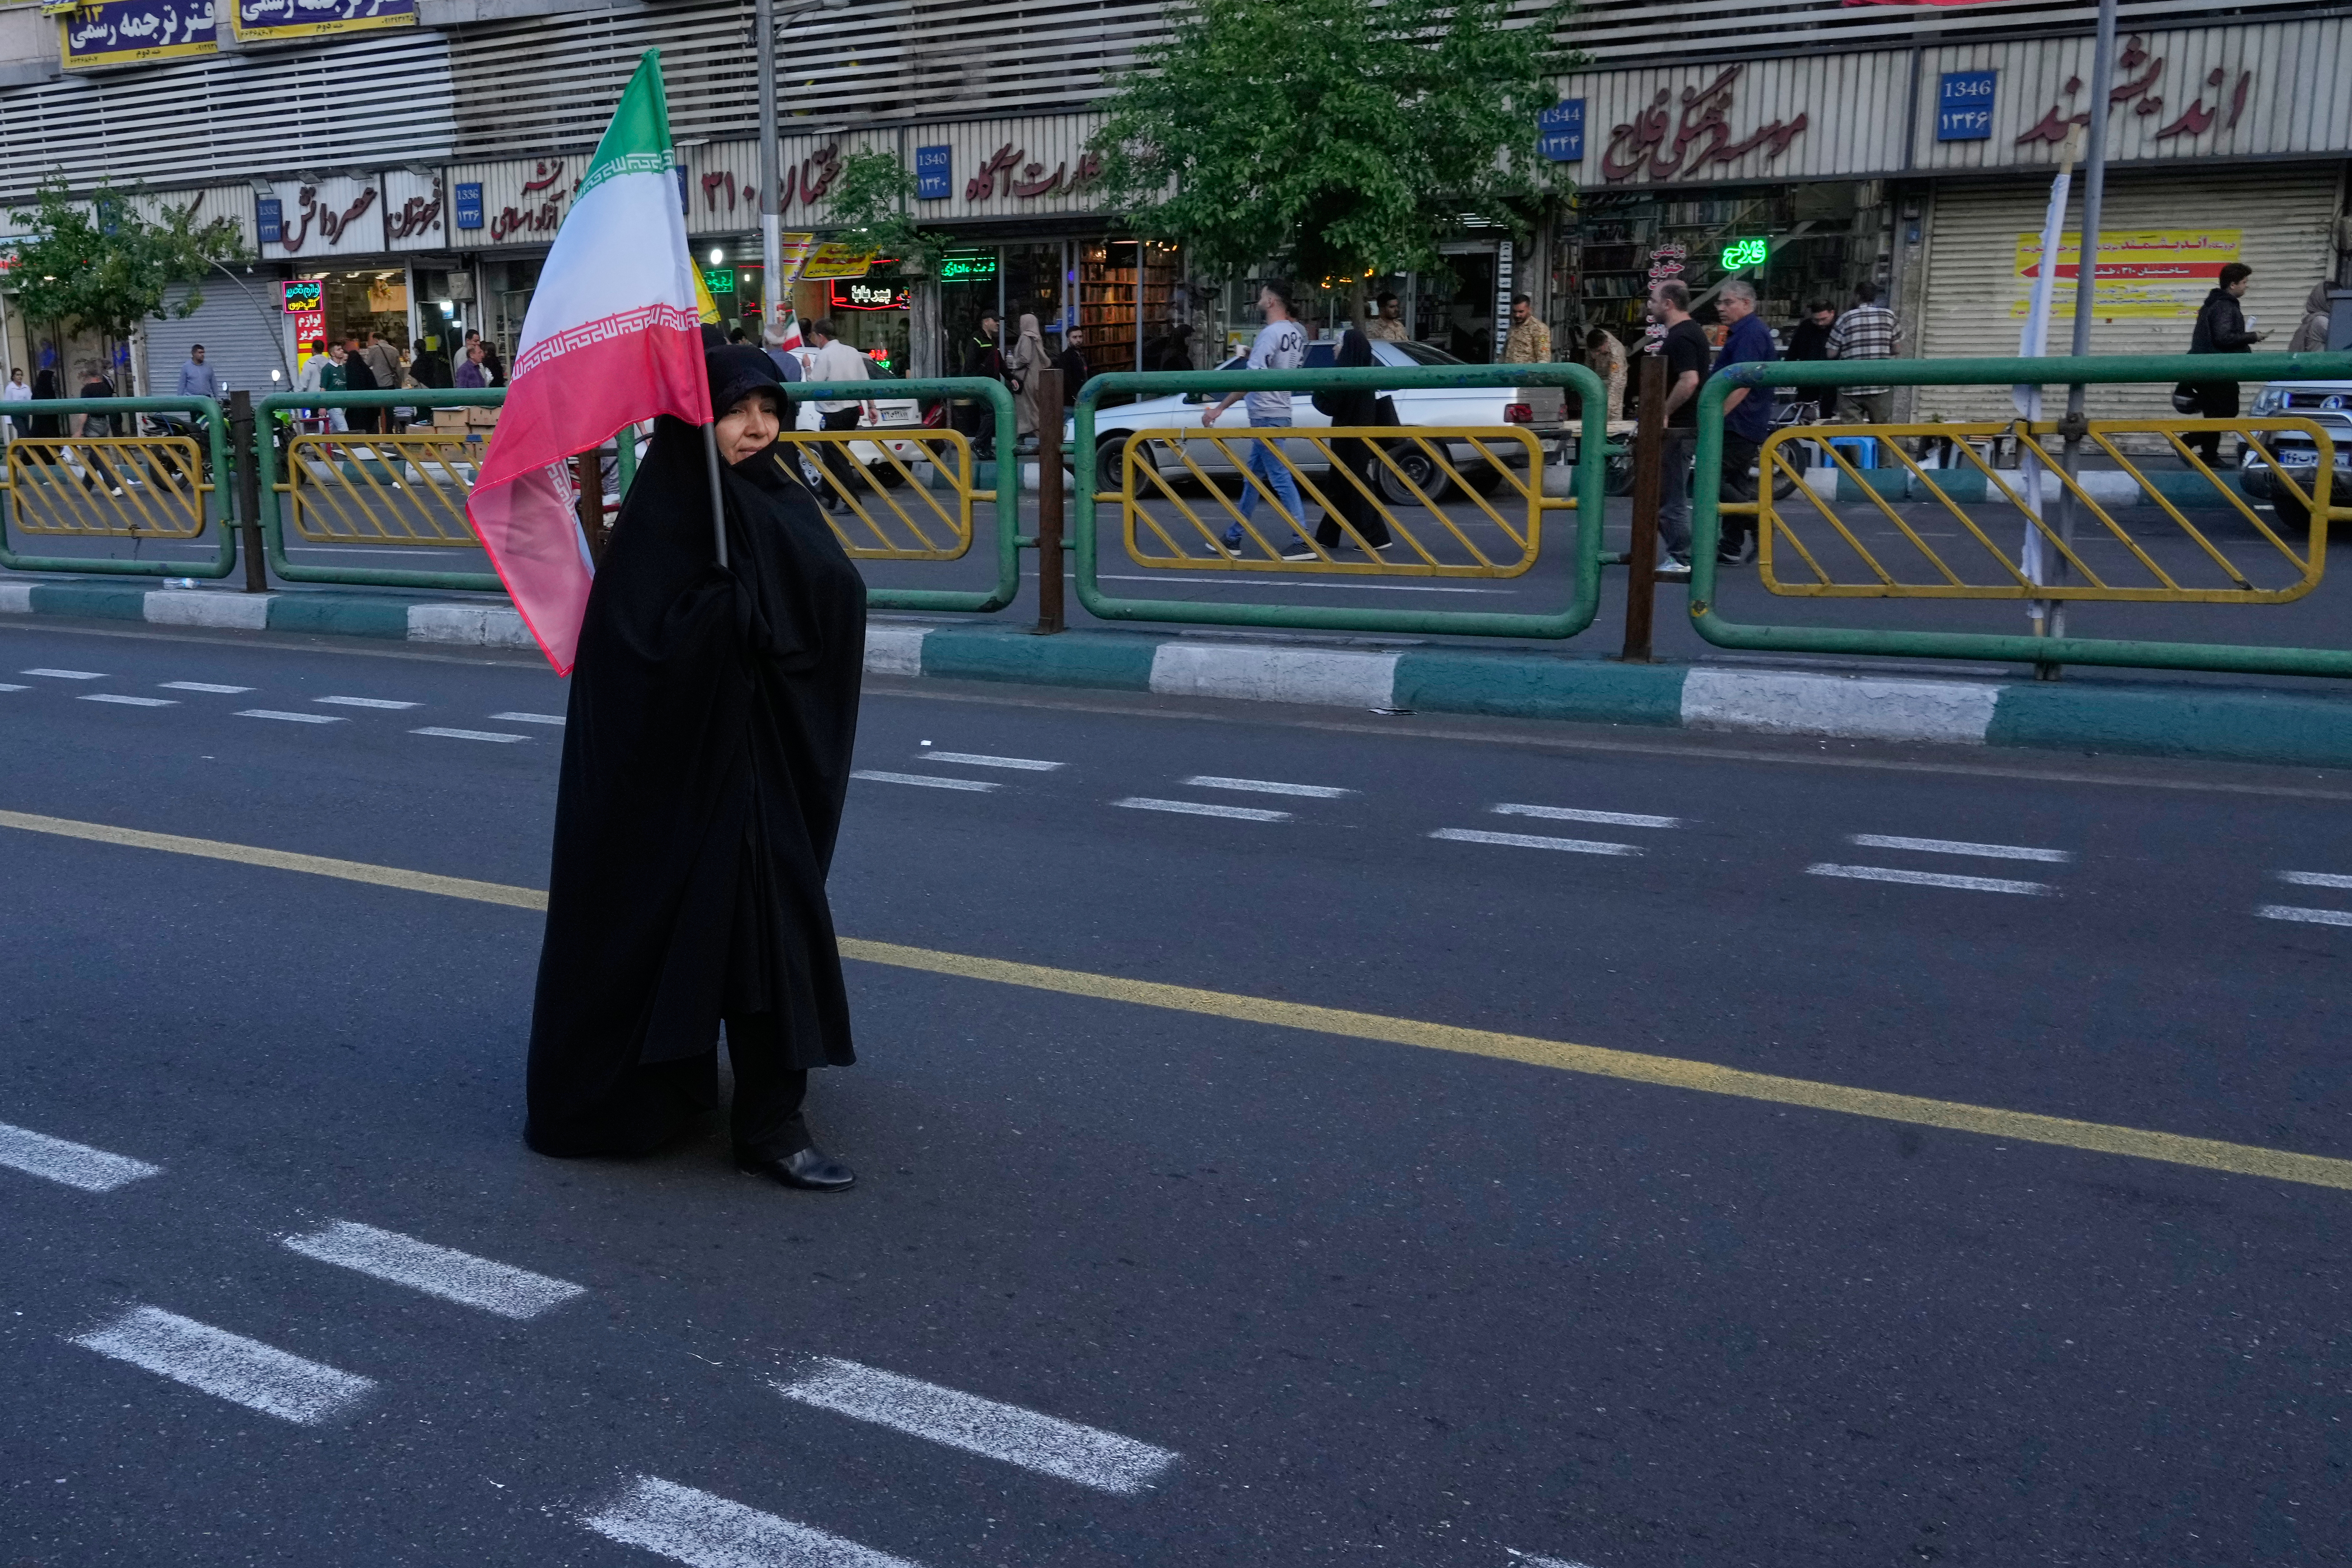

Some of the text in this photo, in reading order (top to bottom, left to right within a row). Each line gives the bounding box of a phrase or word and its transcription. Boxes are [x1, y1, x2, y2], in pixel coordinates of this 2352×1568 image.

[120, 4, 178, 45] ترجمه
[70, 23, 117, 49] رسمی
[1944, 80, 1992, 98] 1346
[2016, 35, 2251, 146] اندیشند
[1542, 107, 1581, 123] 1344
[1942, 110, 1989, 131] ۱۳۴۶
[1542, 135, 1580, 153] ۱۳۴۴
[918, 153, 947, 166] 1340
[966, 143, 1025, 201] آگاه
[919, 178, 947, 191] ۱۳۴۰
[456, 189, 479, 200] 1336
[458, 210, 479, 221] ۱۳۳۶
[1650, 244, 1686, 259] پزشکی
[1722, 240, 1766, 270] فلاح
[1648, 260, 1685, 278] حقوق
[2137, 266, 2191, 277] ساختمان
[284, 283, 321, 299] لوازم تحریر
[851, 285, 891, 305] پیر بابا
[298, 314, 322, 327] لوازم
[299, 327, 324, 341] تحریر
